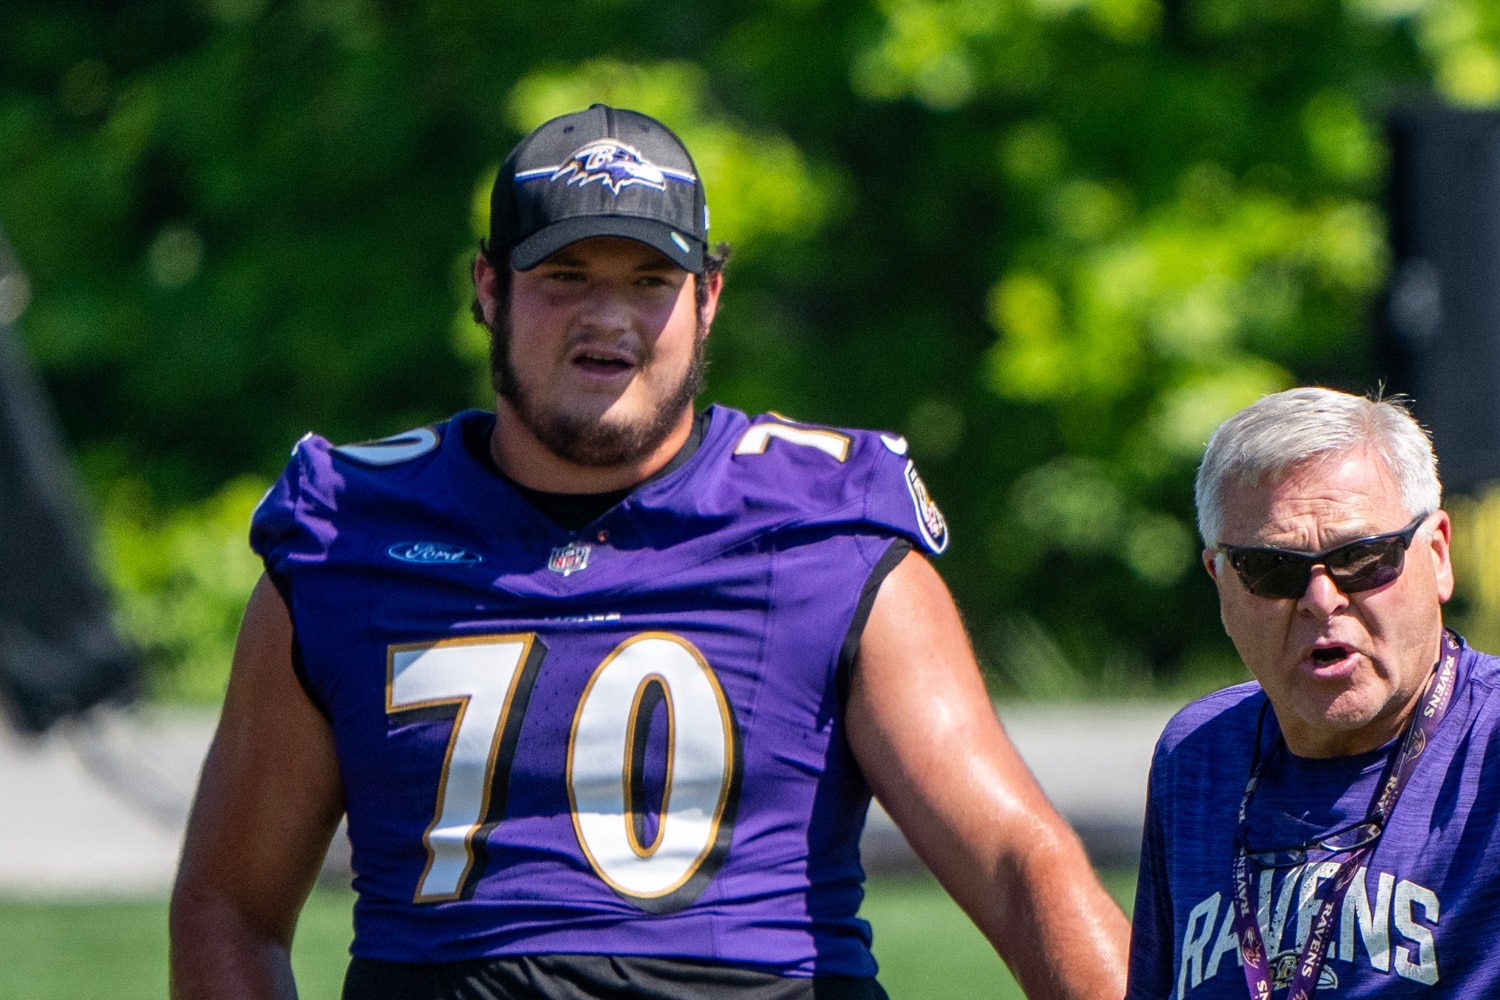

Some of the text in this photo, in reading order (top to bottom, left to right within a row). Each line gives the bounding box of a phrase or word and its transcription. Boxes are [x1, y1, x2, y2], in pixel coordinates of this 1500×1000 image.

[1424, 654, 1455, 719] RAVENS
[385, 631, 742, 912] 70
[1302, 901, 1335, 978] RAVENS
